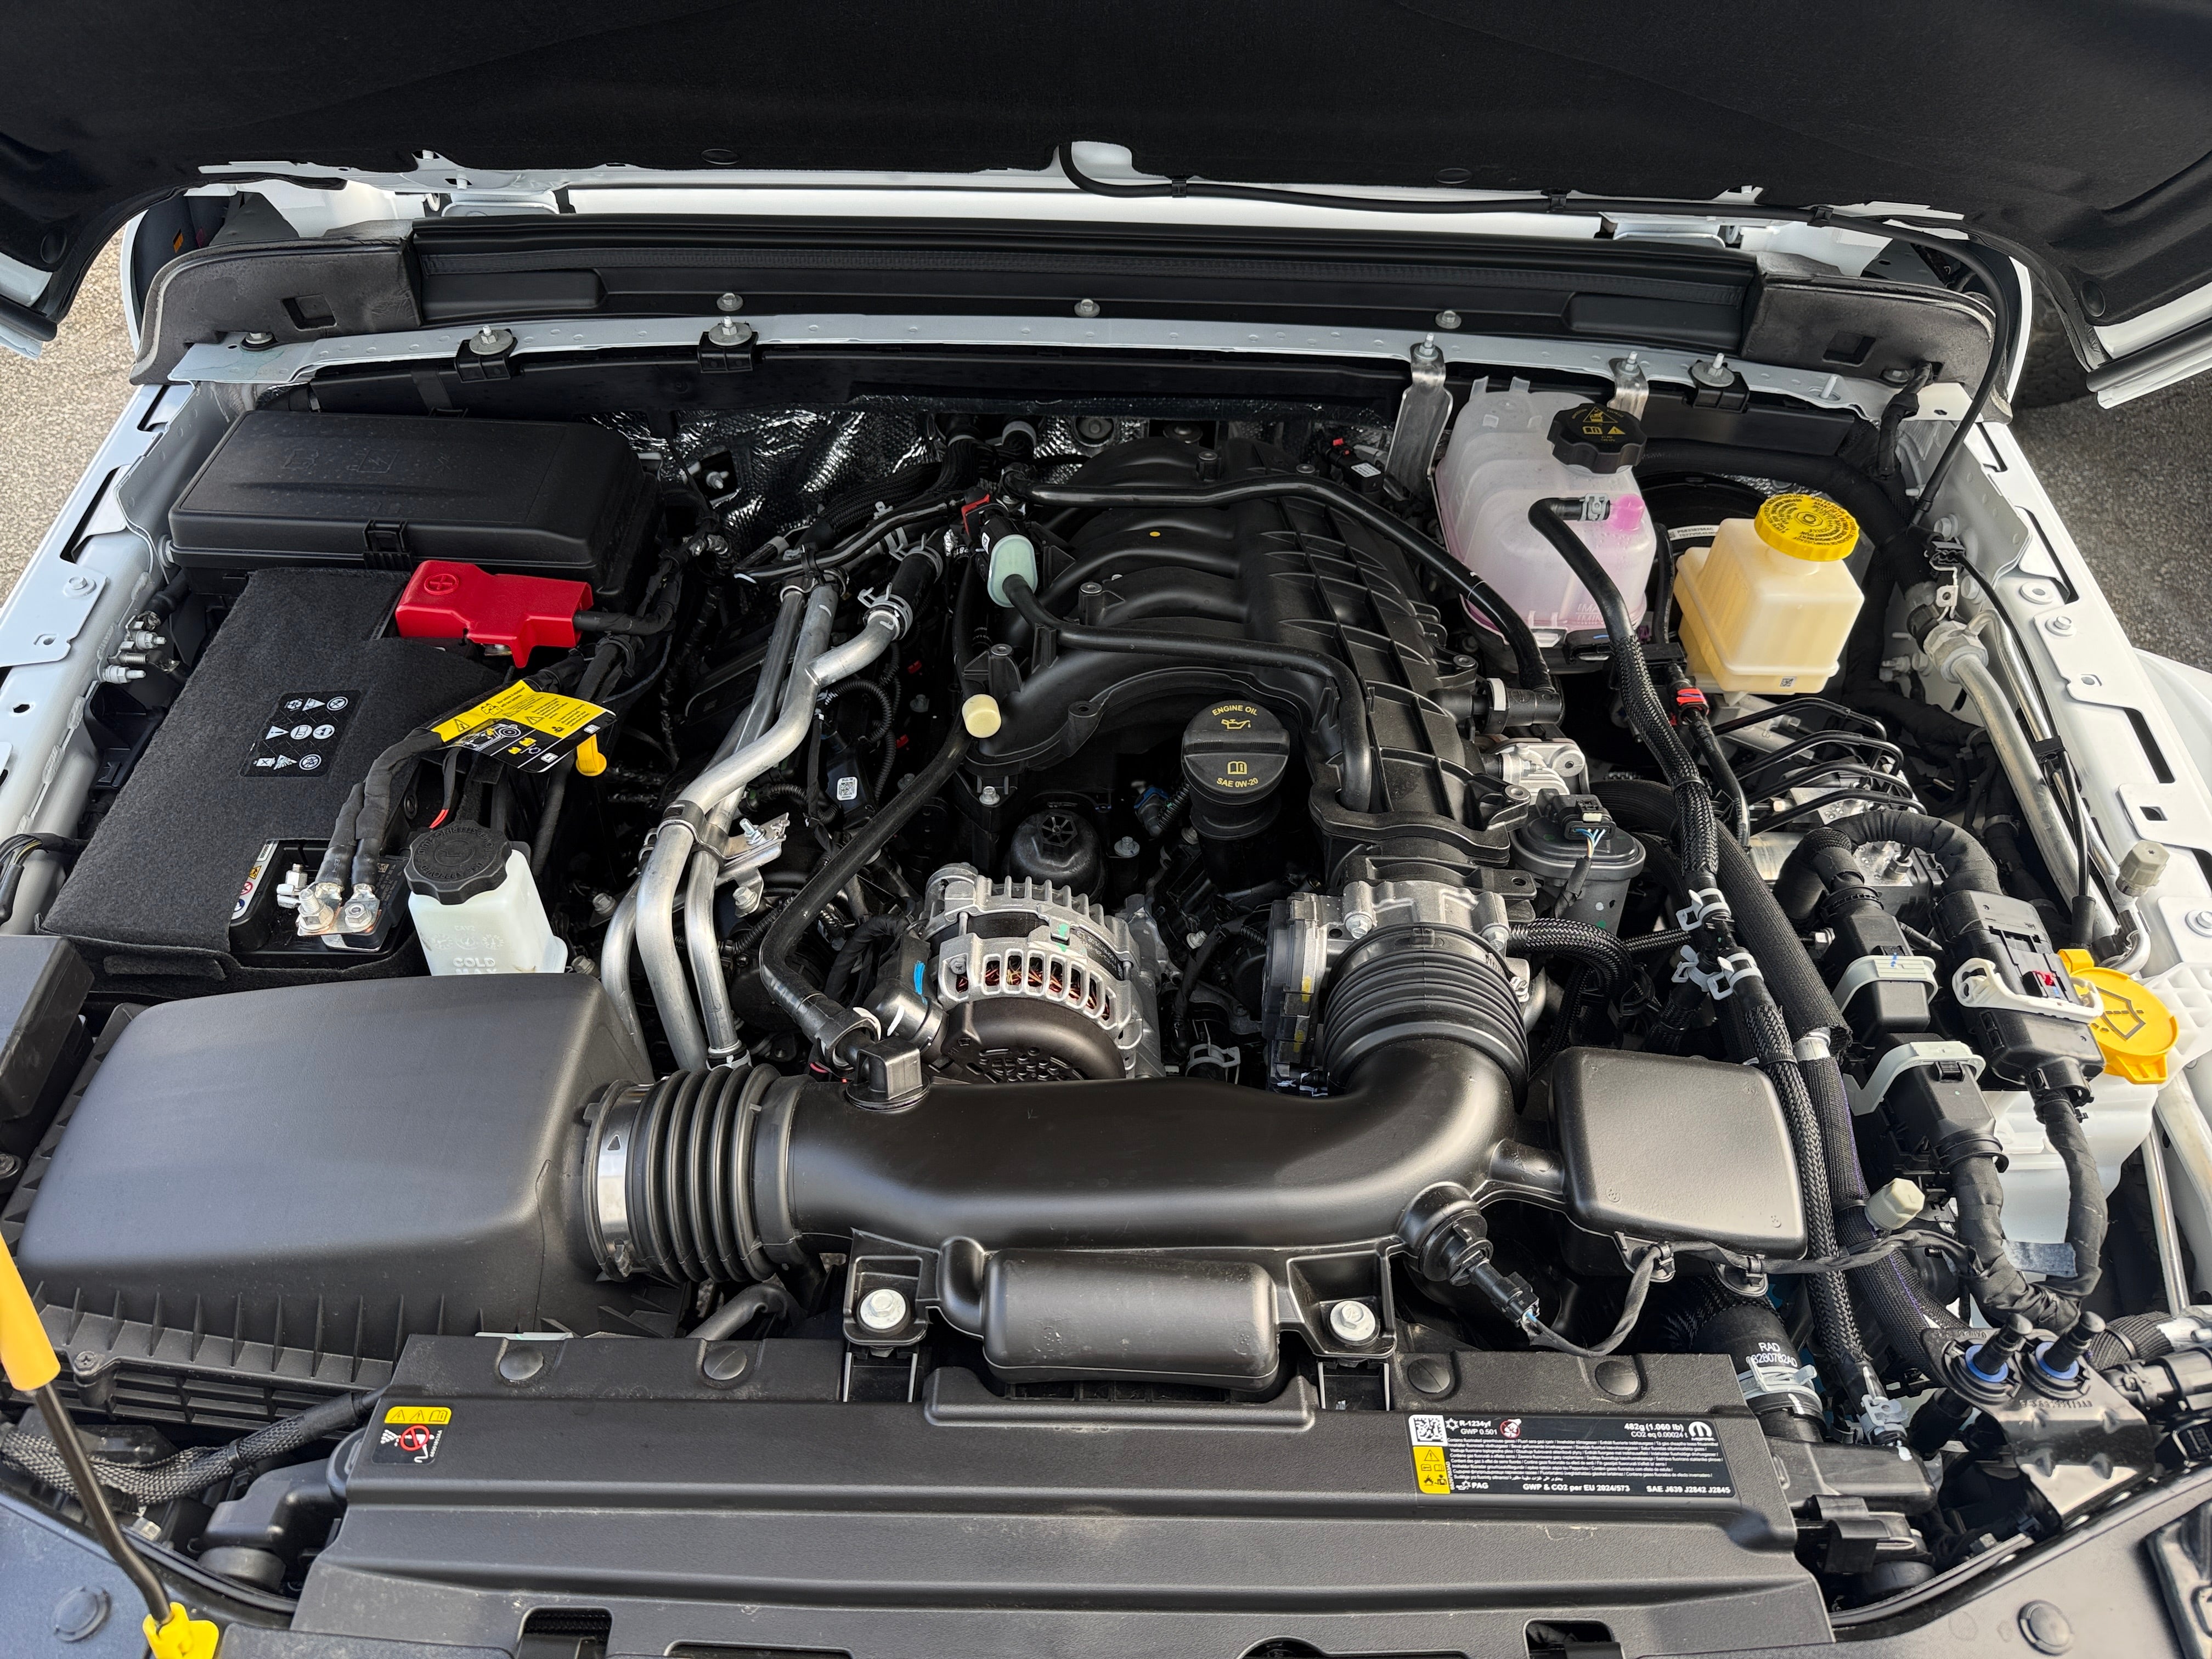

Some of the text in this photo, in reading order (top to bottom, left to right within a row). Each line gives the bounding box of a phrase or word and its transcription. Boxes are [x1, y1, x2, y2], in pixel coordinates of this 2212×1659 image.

[1211, 704, 1257, 716] ENGINE OIL
[1216, 777, 1259, 788] SAE 0W-20
[435, 827, 478, 837] STEERING
[420, 861, 484, 879] USE APPROVED
[453, 957, 495, 967] COLD
[1758, 1342, 1781, 1352] RAD
[1750, 1353, 1797, 1367] 8280782AD
[1624, 1423, 1684, 1432] 482g (1.060 lb)
